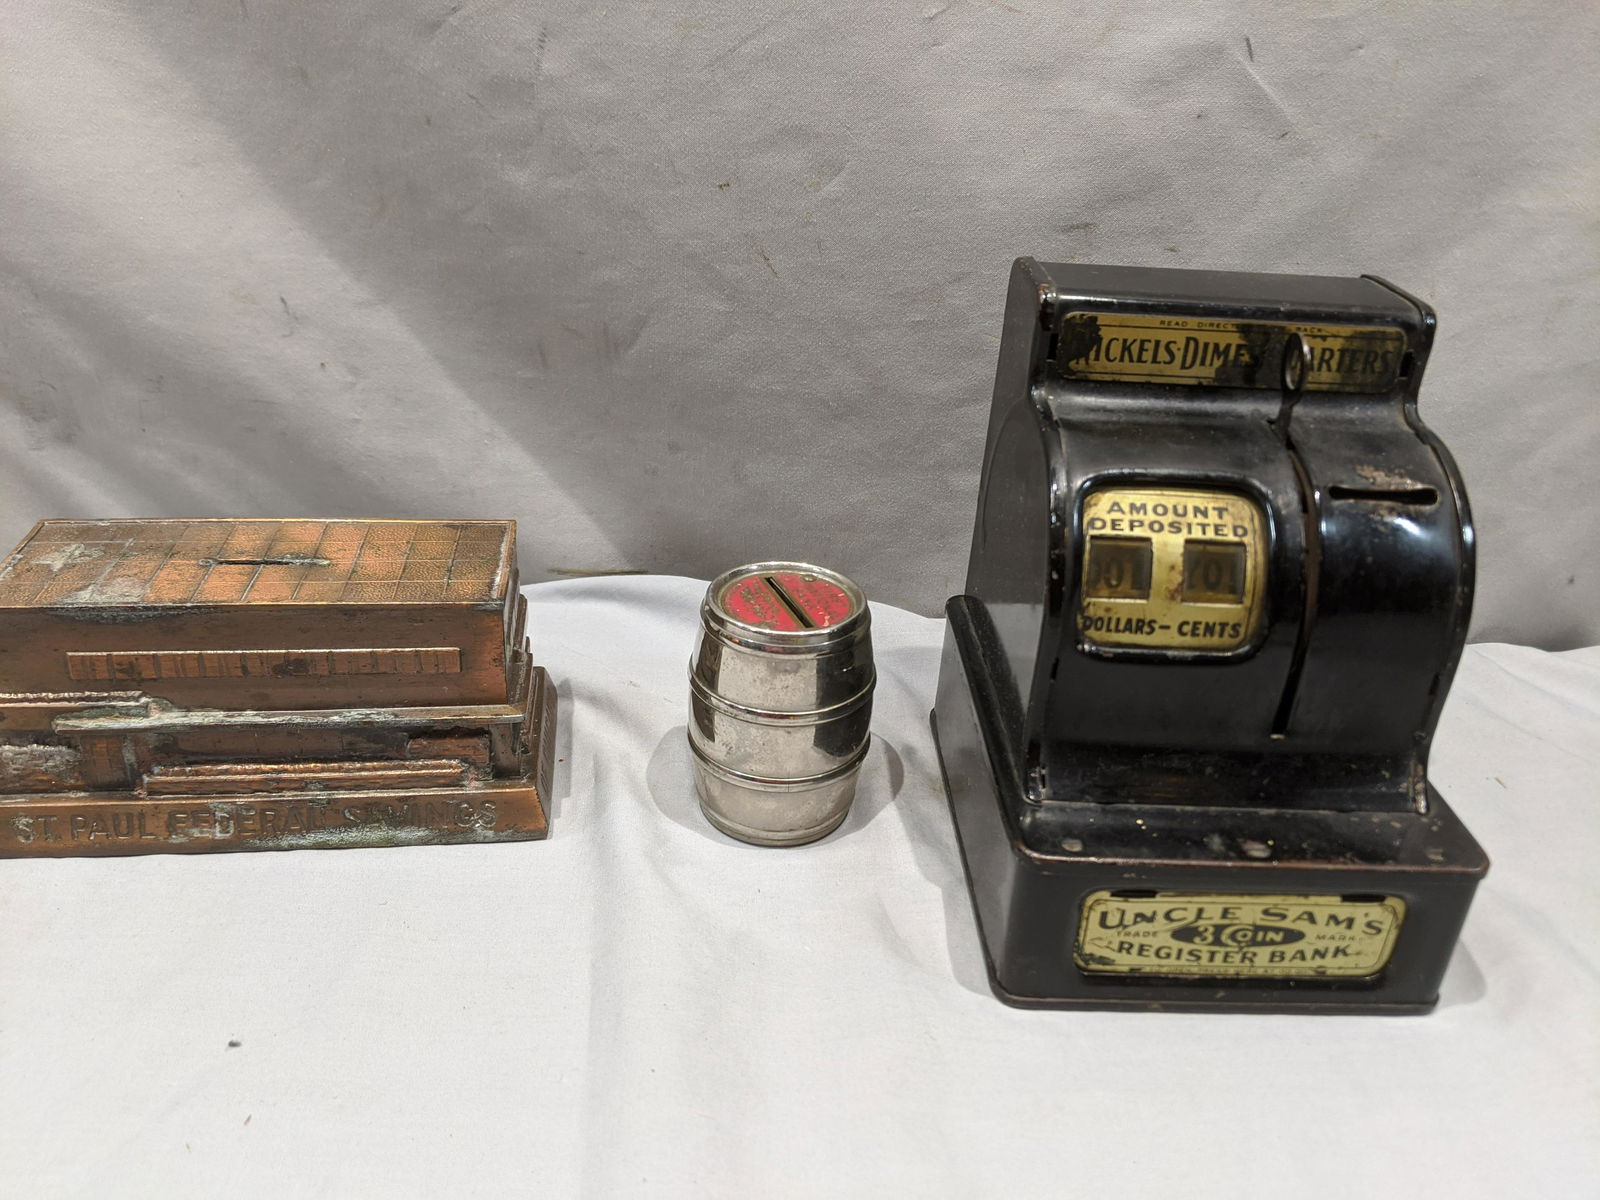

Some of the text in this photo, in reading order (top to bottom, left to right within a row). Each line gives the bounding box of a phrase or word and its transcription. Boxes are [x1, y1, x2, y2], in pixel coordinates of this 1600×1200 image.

[1159, 319, 1188, 328] READ
[1072, 336, 1177, 366] ICKELS
[1107, 501, 1229, 520] AMOUNT
[1088, 517, 1249, 538] DEPOSITED
[1177, 620, 1242, 639] CENTS
[70, 811, 157, 841] PAUL
[166, 804, 325, 840] FEDERAL
[1098, 907, 1384, 936] UNCLE SAM'S
[1116, 930, 1158, 939] TRADE
[1192, 924, 1285, 947] 3 COIN
[1315, 934, 1357, 942] MARK
[1117, 940, 1351, 964] REGISTER BANK
